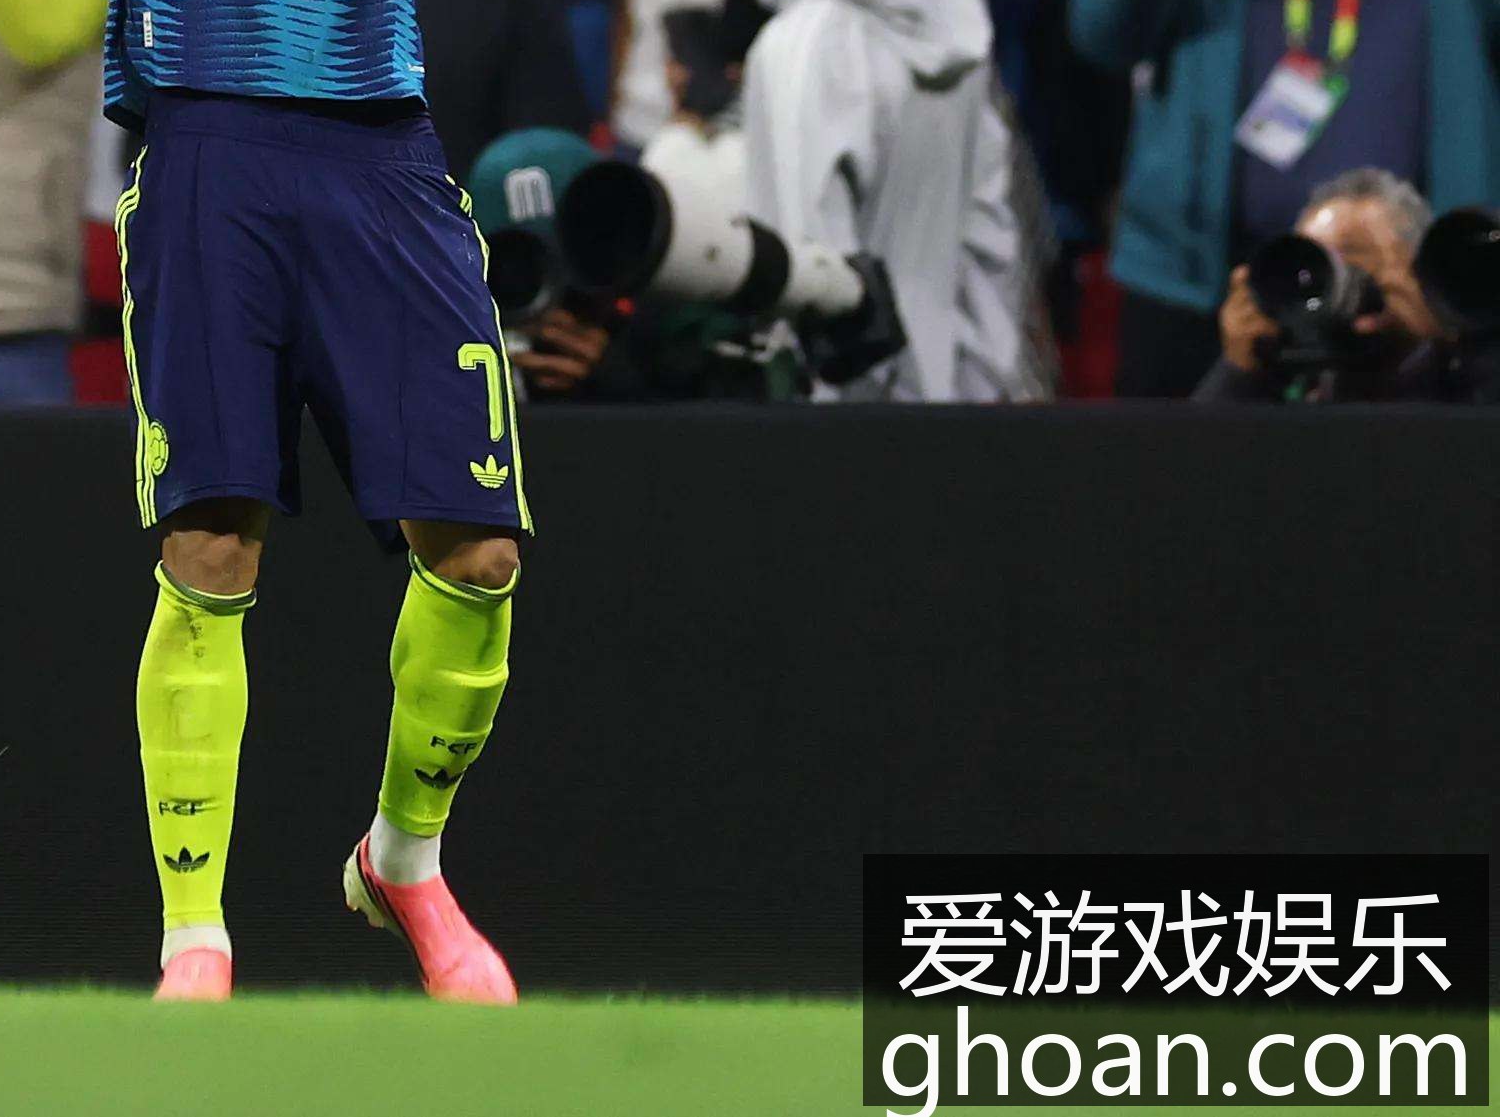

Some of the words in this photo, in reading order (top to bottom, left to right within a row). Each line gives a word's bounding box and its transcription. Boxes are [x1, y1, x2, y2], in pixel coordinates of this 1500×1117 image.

[457, 343, 504, 442] 7
[430, 736, 479, 754] FCF
[158, 799, 208, 817] FCF
